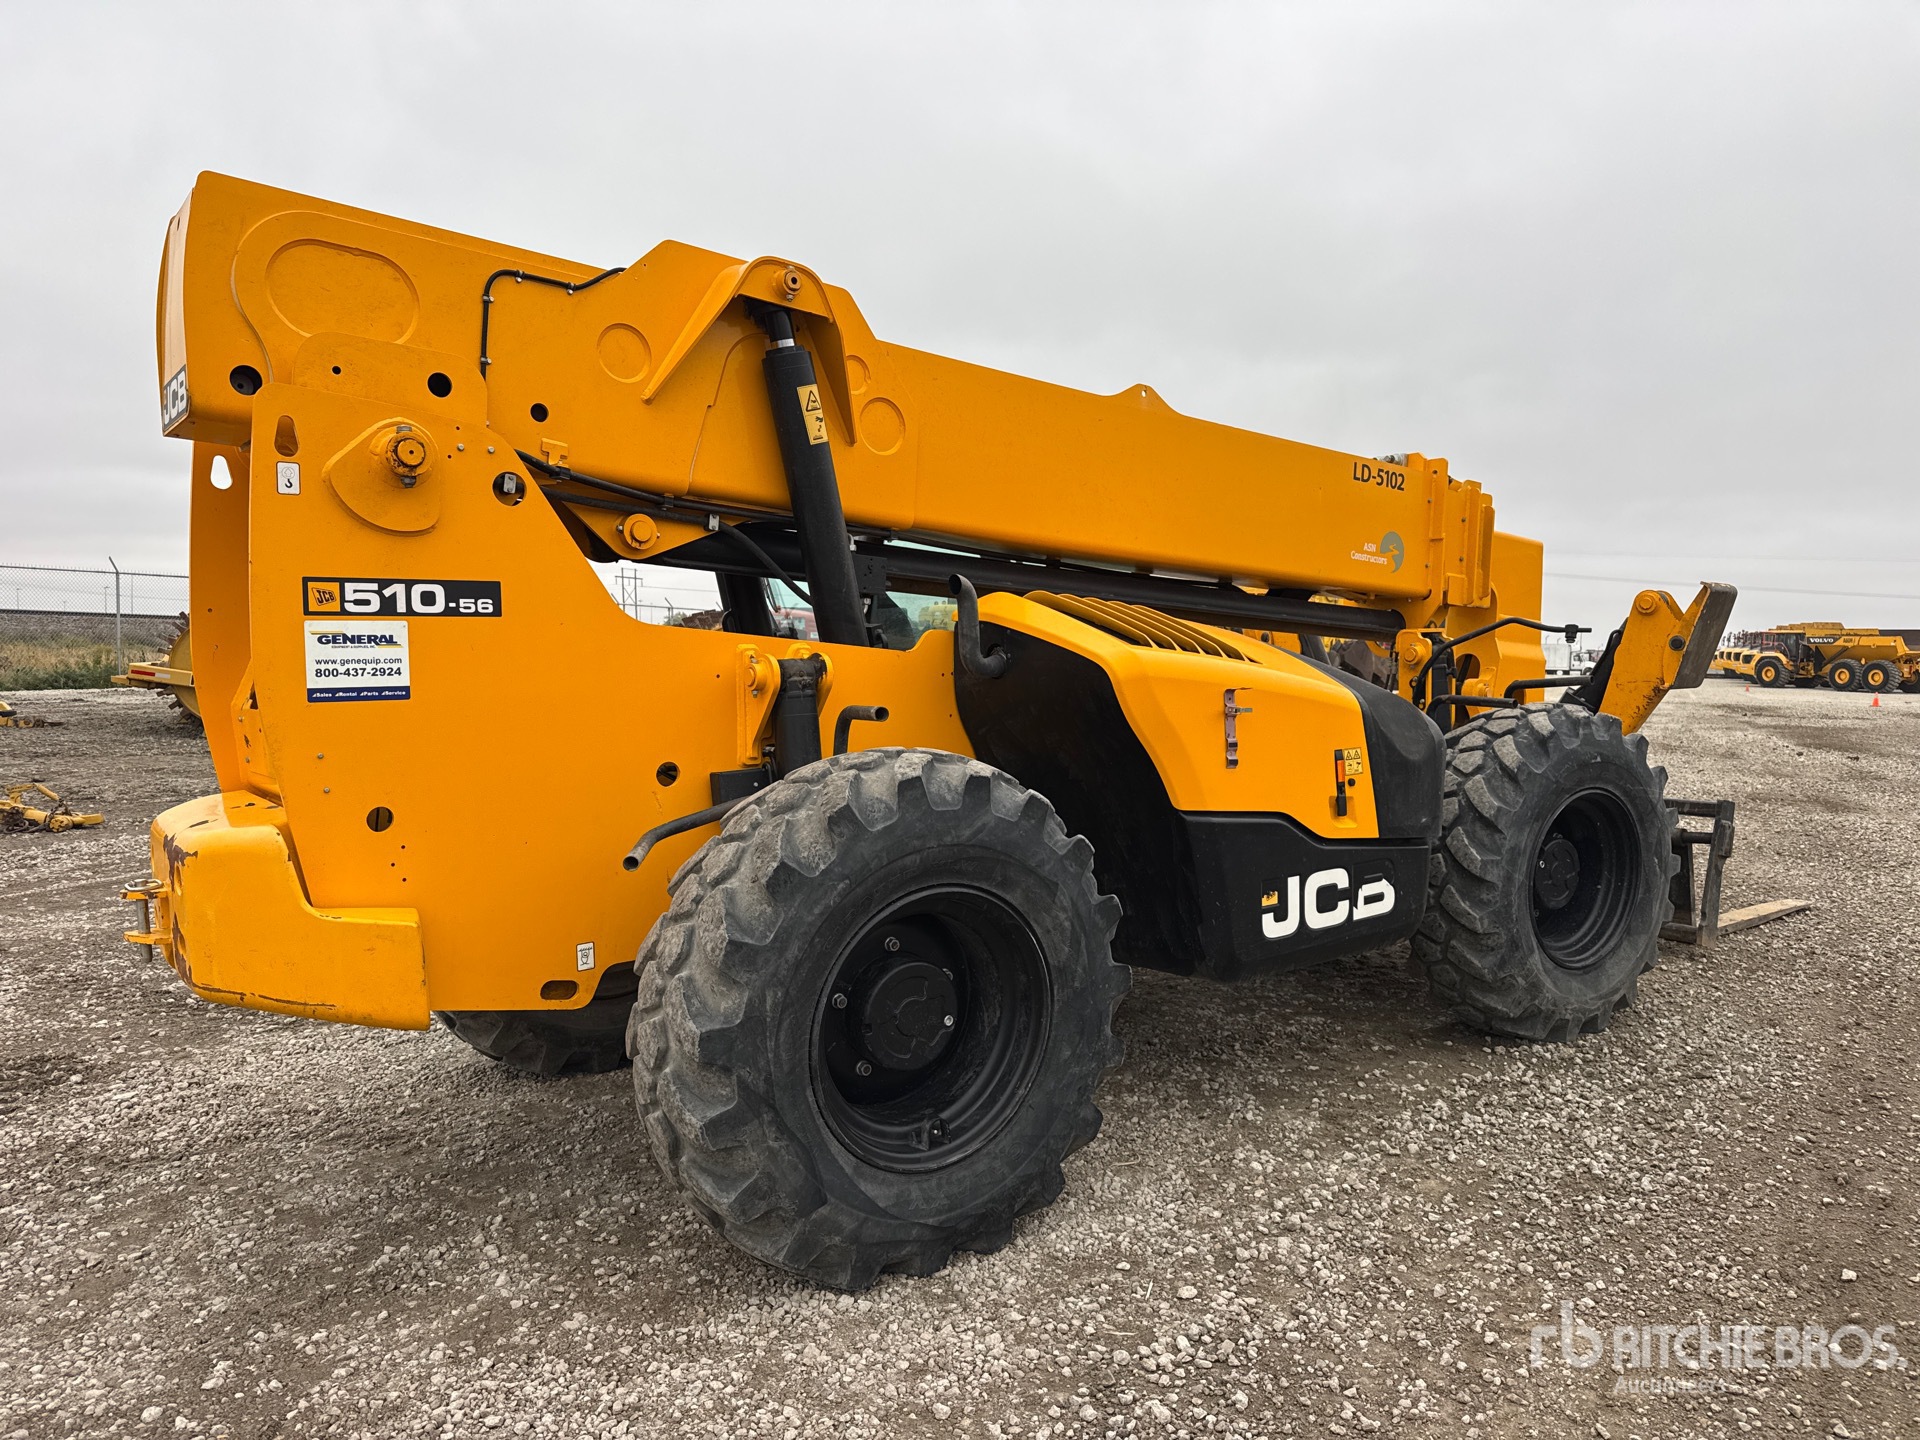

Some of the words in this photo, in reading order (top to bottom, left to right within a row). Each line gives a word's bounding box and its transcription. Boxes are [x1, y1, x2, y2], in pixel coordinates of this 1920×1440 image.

[164, 370, 187, 425] JCB
[1353, 462, 1405, 491] LD-5102
[1363, 542, 1376, 553] ASN
[1350, 551, 1388, 565] Constructors
[314, 588, 336, 605] JCB
[343, 582, 494, 614] 510-56
[316, 634, 398, 646] GENERAL
[314, 657, 402, 667] www.genequip.com
[314, 667, 402, 678] 800-437-2924
[1261, 866, 1396, 939] JCB
